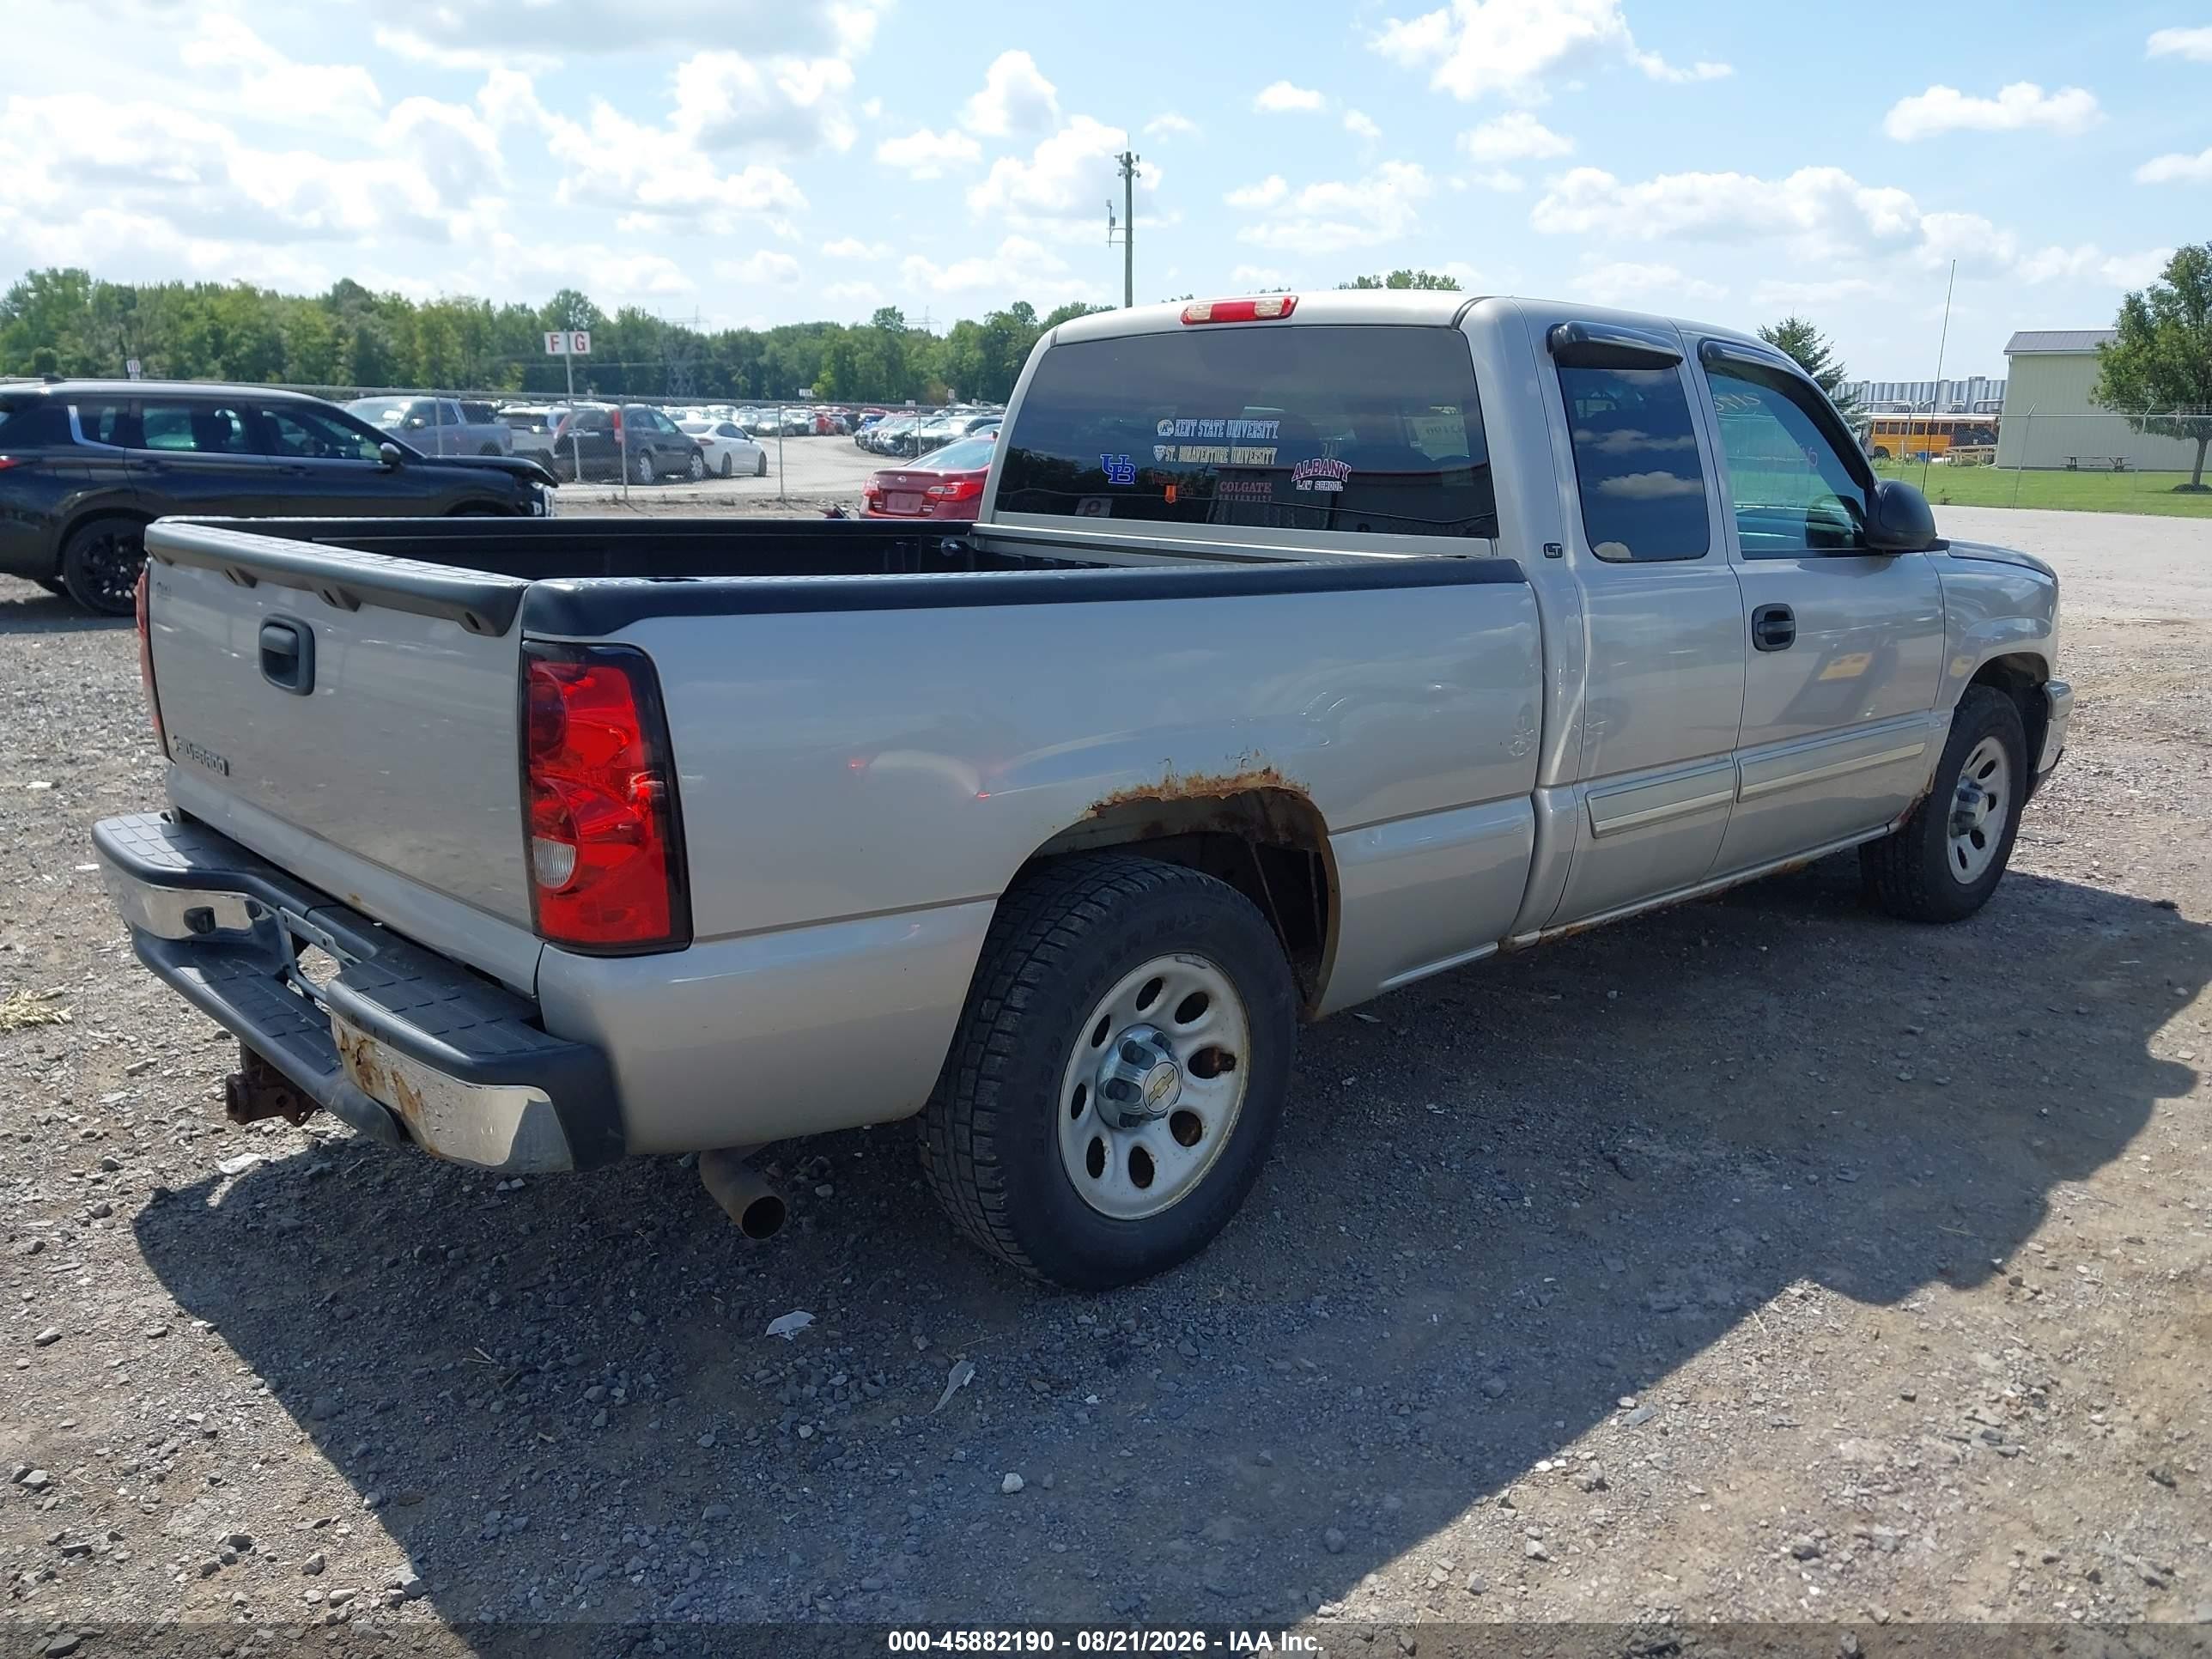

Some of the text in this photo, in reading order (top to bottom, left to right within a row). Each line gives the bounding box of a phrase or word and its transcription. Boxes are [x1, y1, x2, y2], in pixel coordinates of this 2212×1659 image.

[550, 334, 559, 352] F
[574, 333, 586, 351] G
[1175, 419, 1279, 440] KENT STATE UNIVERSITY
[1165, 445, 1278, 465] ST. BONAVENTURE UNIVERSITY
[1291, 458, 1352, 483] ALBANY
[1219, 481, 1273, 493] COLGATE
[1296, 480, 1344, 492] LAW SCHOOL
[1545, 544, 1561, 556] LT
